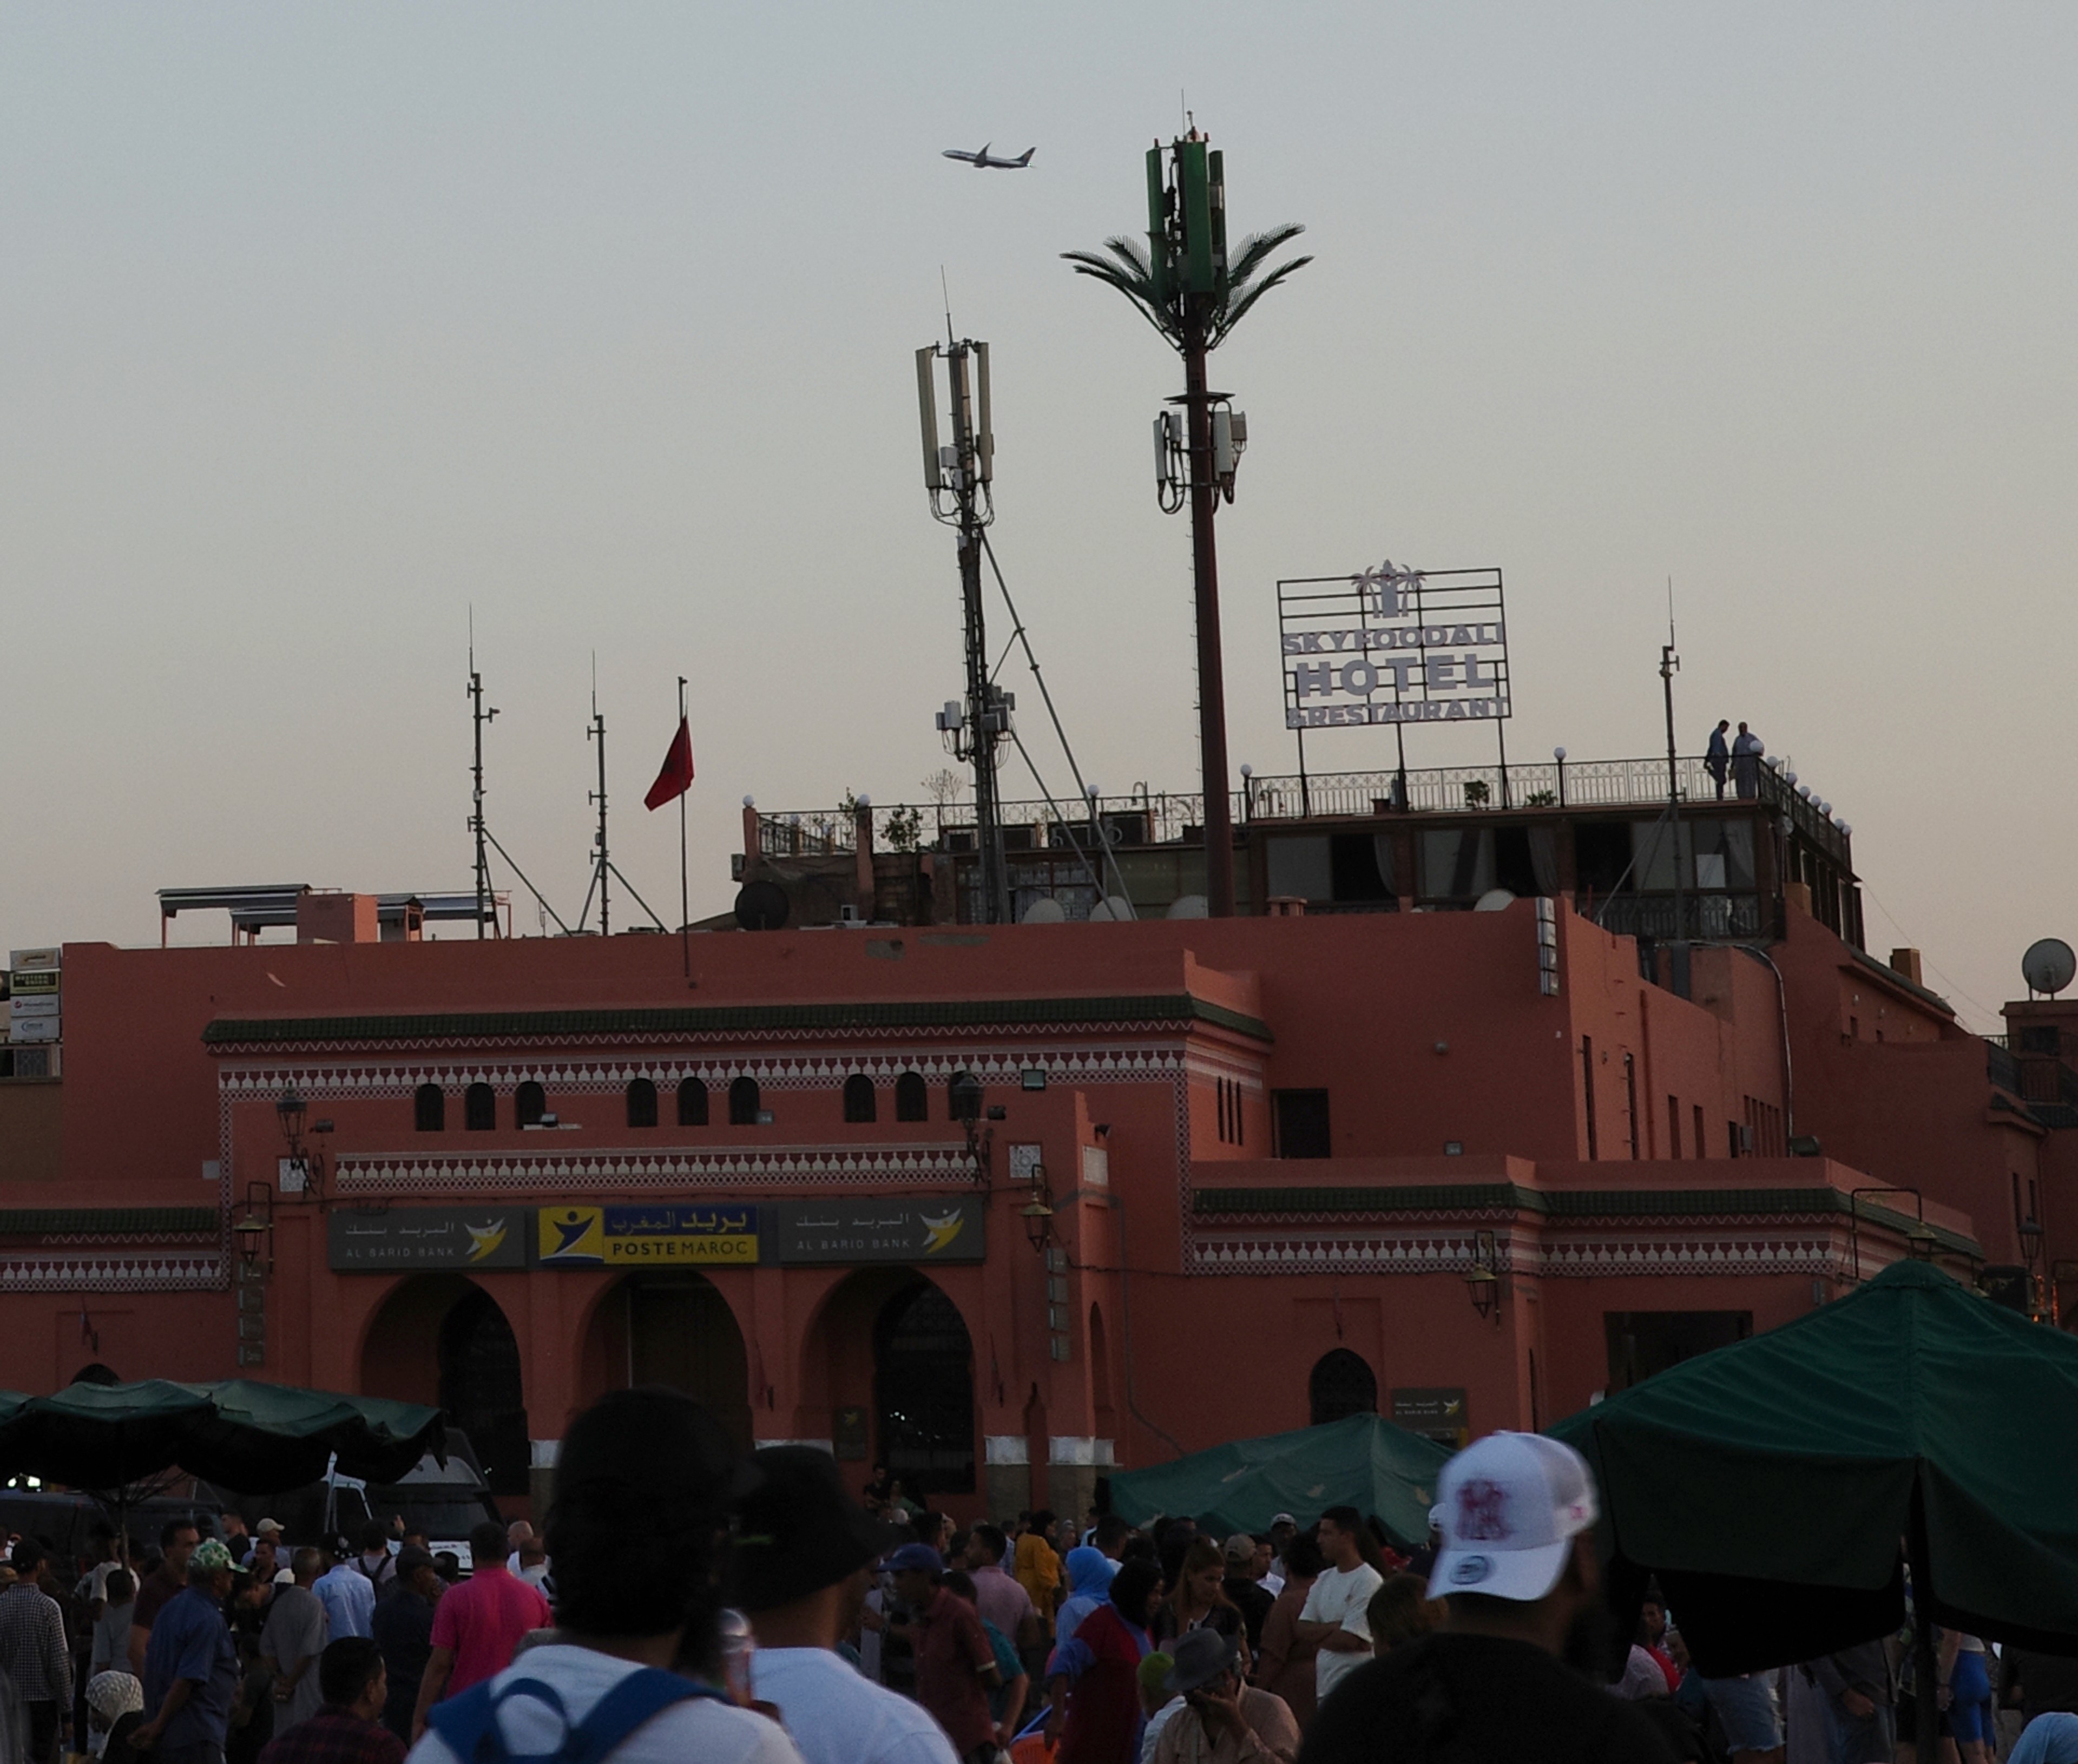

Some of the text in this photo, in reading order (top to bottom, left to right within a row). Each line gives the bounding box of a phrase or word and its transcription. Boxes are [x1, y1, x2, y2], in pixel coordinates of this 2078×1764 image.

[1283, 623, 1504, 654] SKYFOODALI
[1297, 654, 1494, 697] HOTEL
[613, 1241, 748, 1255] POSTE MAROC
[797, 1240, 812, 1250] AL
[872, 1239, 910, 1249] BANK
[346, 1247, 455, 1258] AL BARID BANK
